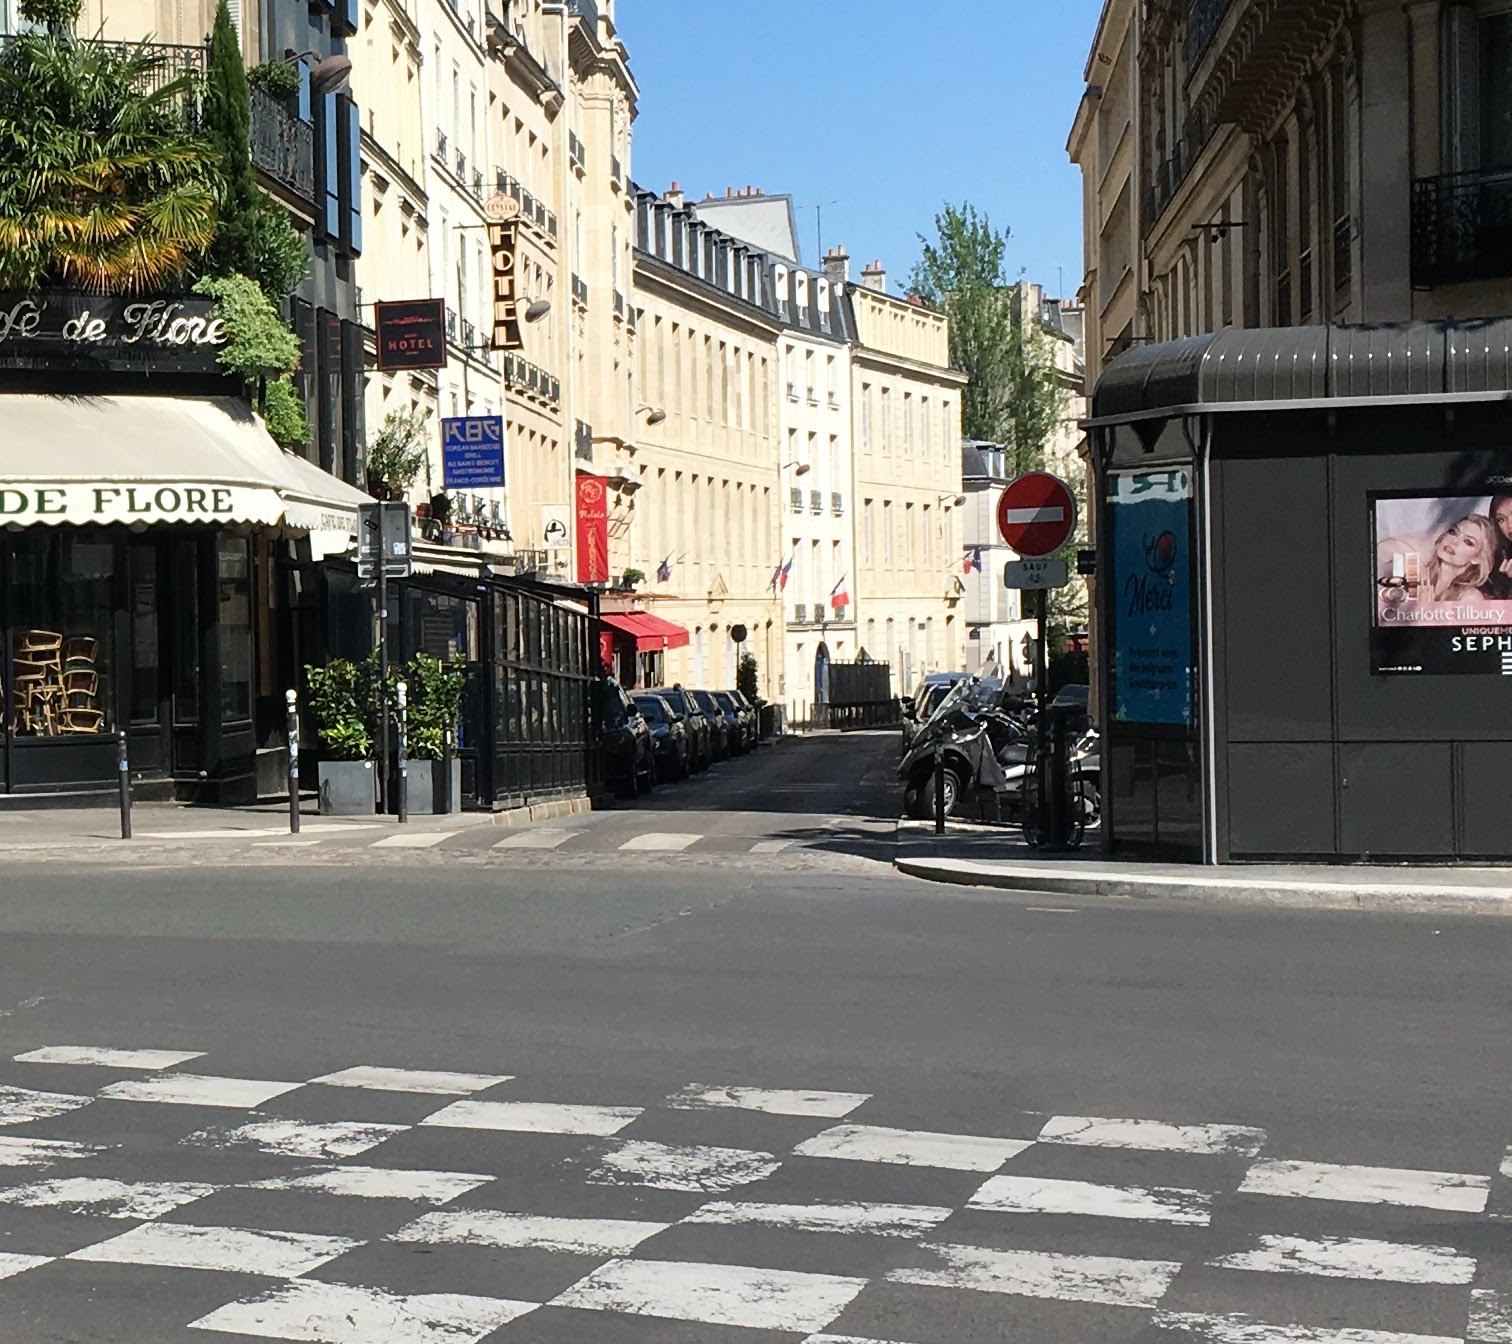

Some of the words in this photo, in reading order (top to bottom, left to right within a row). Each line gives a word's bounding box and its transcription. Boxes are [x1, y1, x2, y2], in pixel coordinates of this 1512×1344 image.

[489, 224, 520, 347] HOTEL
[62, 310, 107, 342] de
[120, 299, 230, 345] Flore
[388, 338, 434, 351] HOTEL
[92, 487, 234, 515] FLORE
[1022, 562, 1048, 571] SAUF
[1124, 572, 1175, 618] Merci
